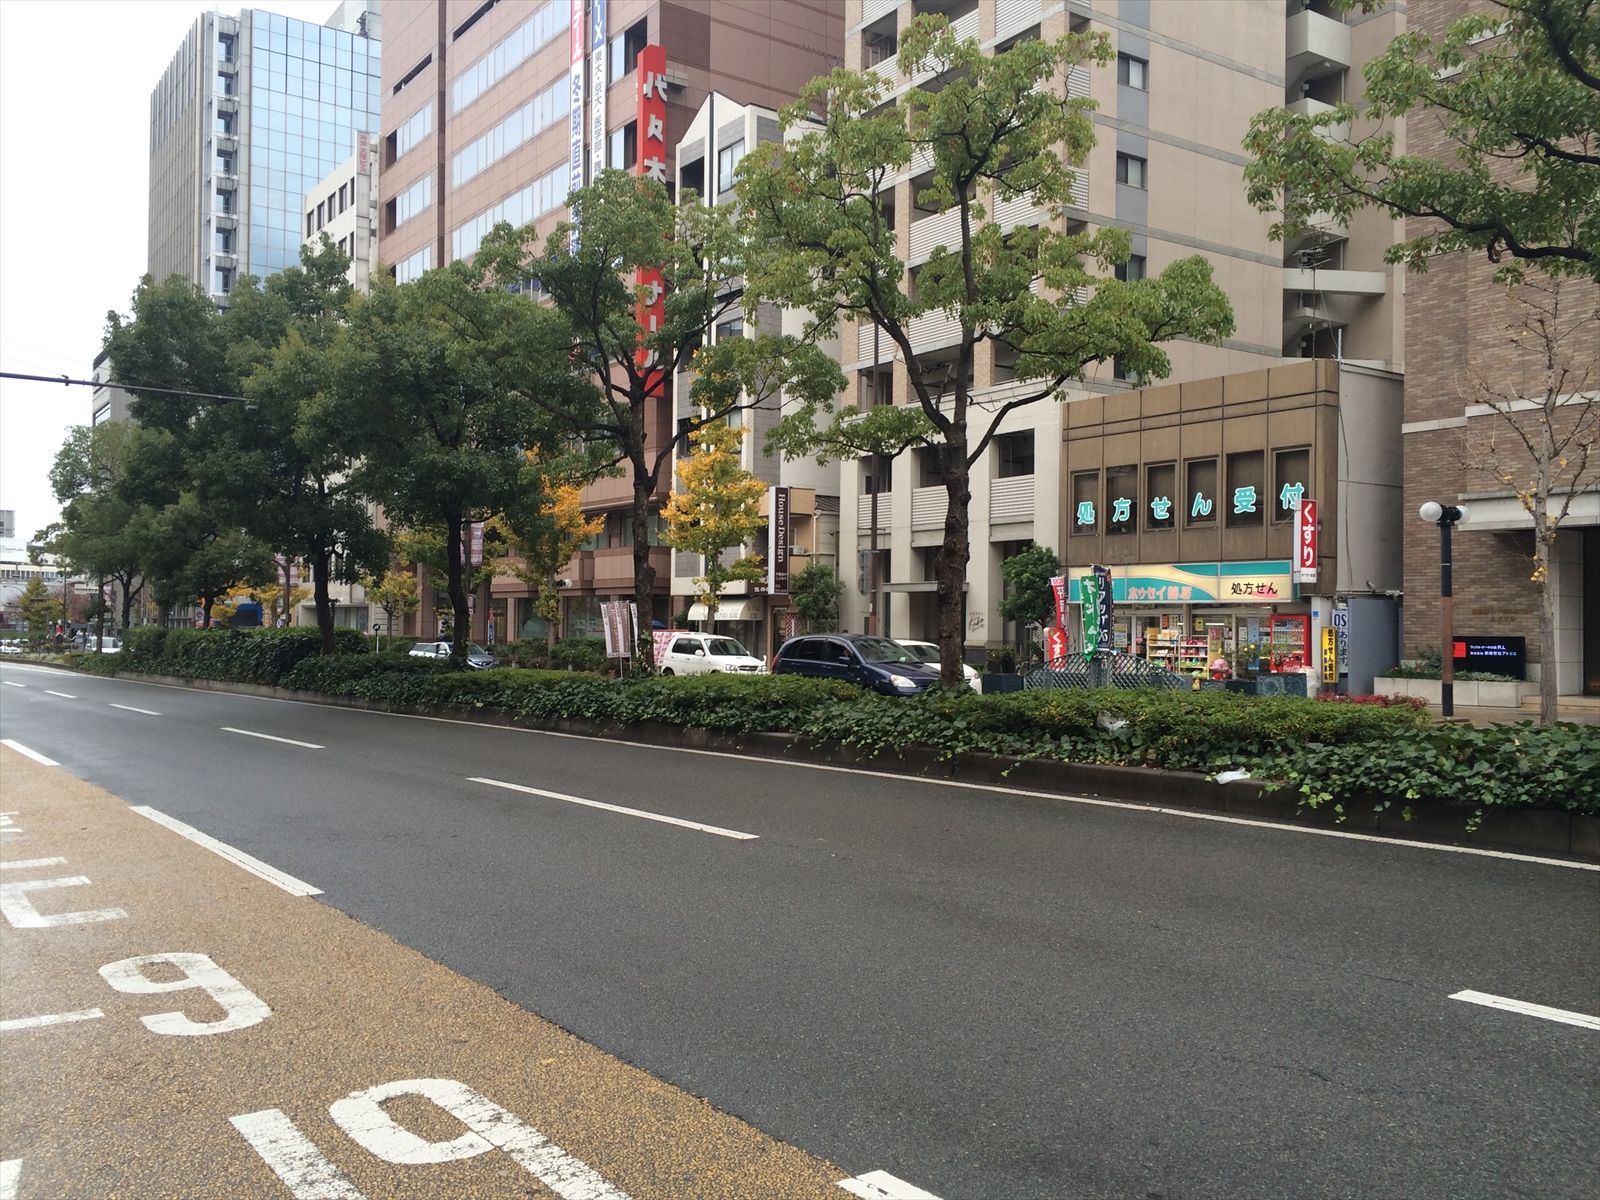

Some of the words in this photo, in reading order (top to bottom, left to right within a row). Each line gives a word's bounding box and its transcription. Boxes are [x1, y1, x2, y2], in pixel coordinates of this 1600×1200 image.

[777, 493, 786, 526] House
[1077, 482, 1305, 525] 処方せん受付
[777, 527, 786, 563] Design
[1302, 502, 1315, 567] くすり
[1231, 582, 1279, 596] 処方せん
[1334, 613, 1347, 627] OS
